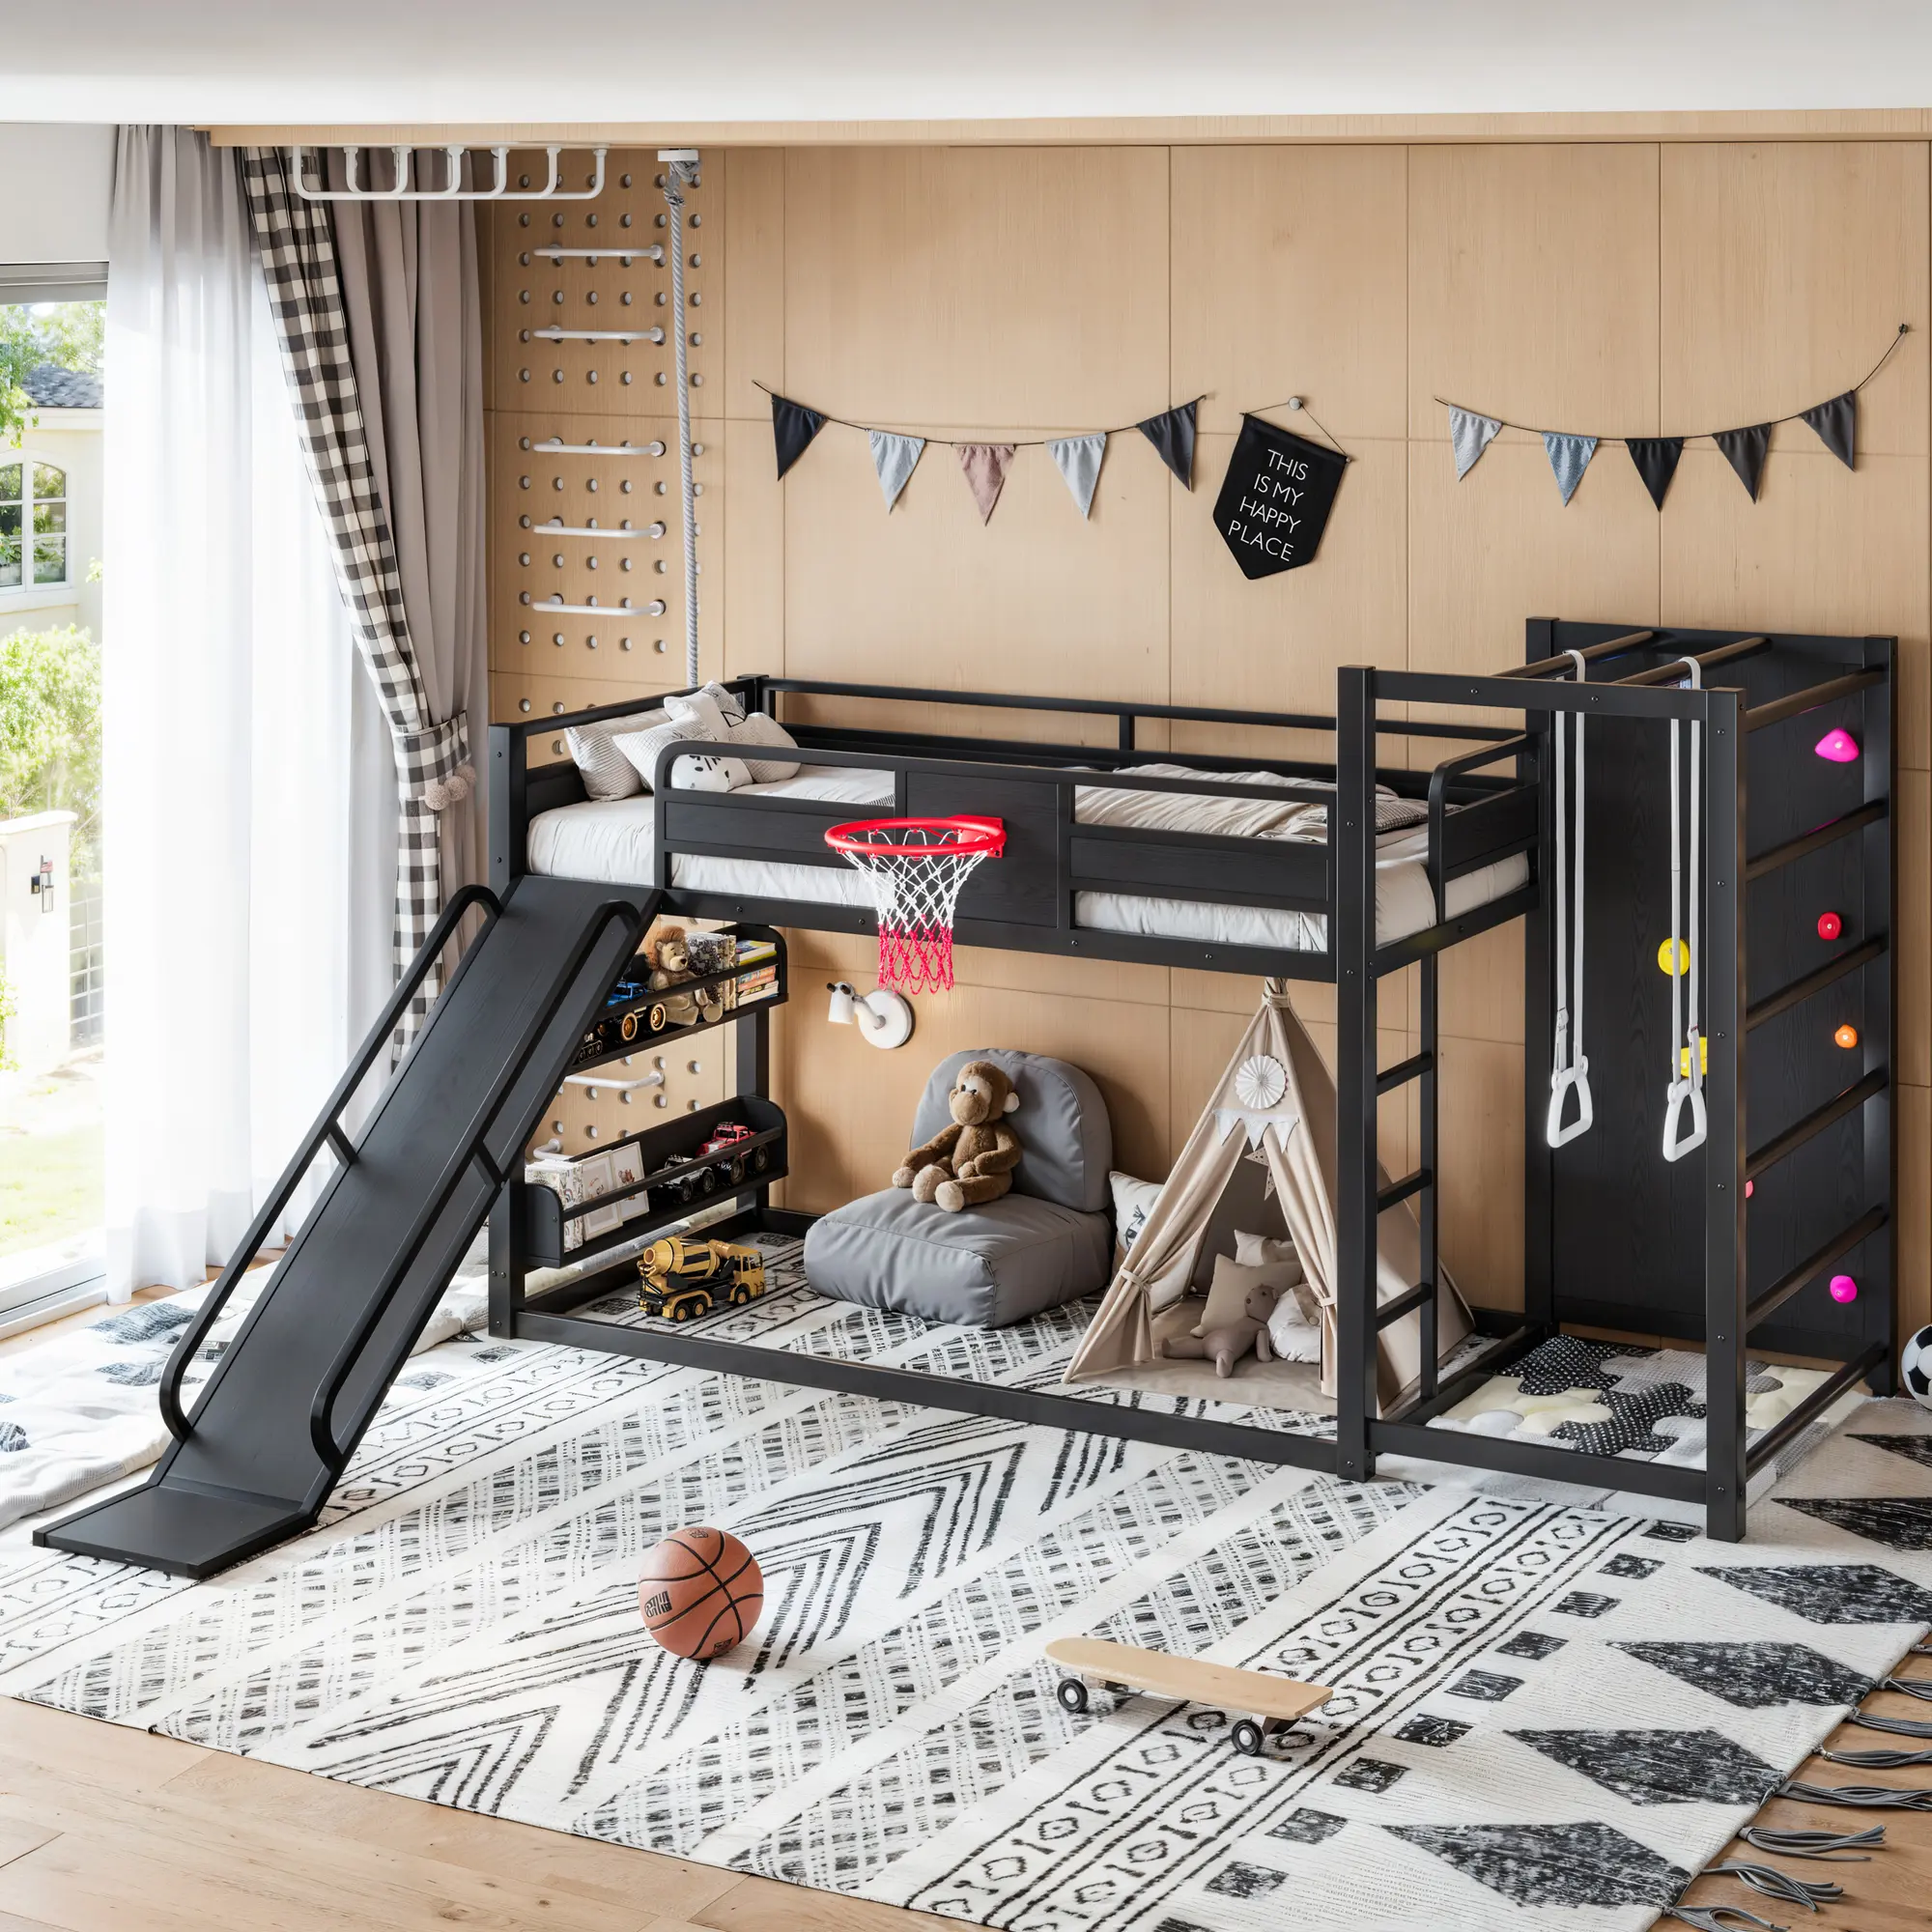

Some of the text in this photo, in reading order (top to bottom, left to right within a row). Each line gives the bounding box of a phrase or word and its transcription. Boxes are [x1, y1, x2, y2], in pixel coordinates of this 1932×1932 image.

[1267, 448, 1309, 481] THIS
[1253, 473, 1304, 506] IS MY
[1239, 496, 1301, 534] HAPPY
[1228, 520, 1294, 562] PLACE
